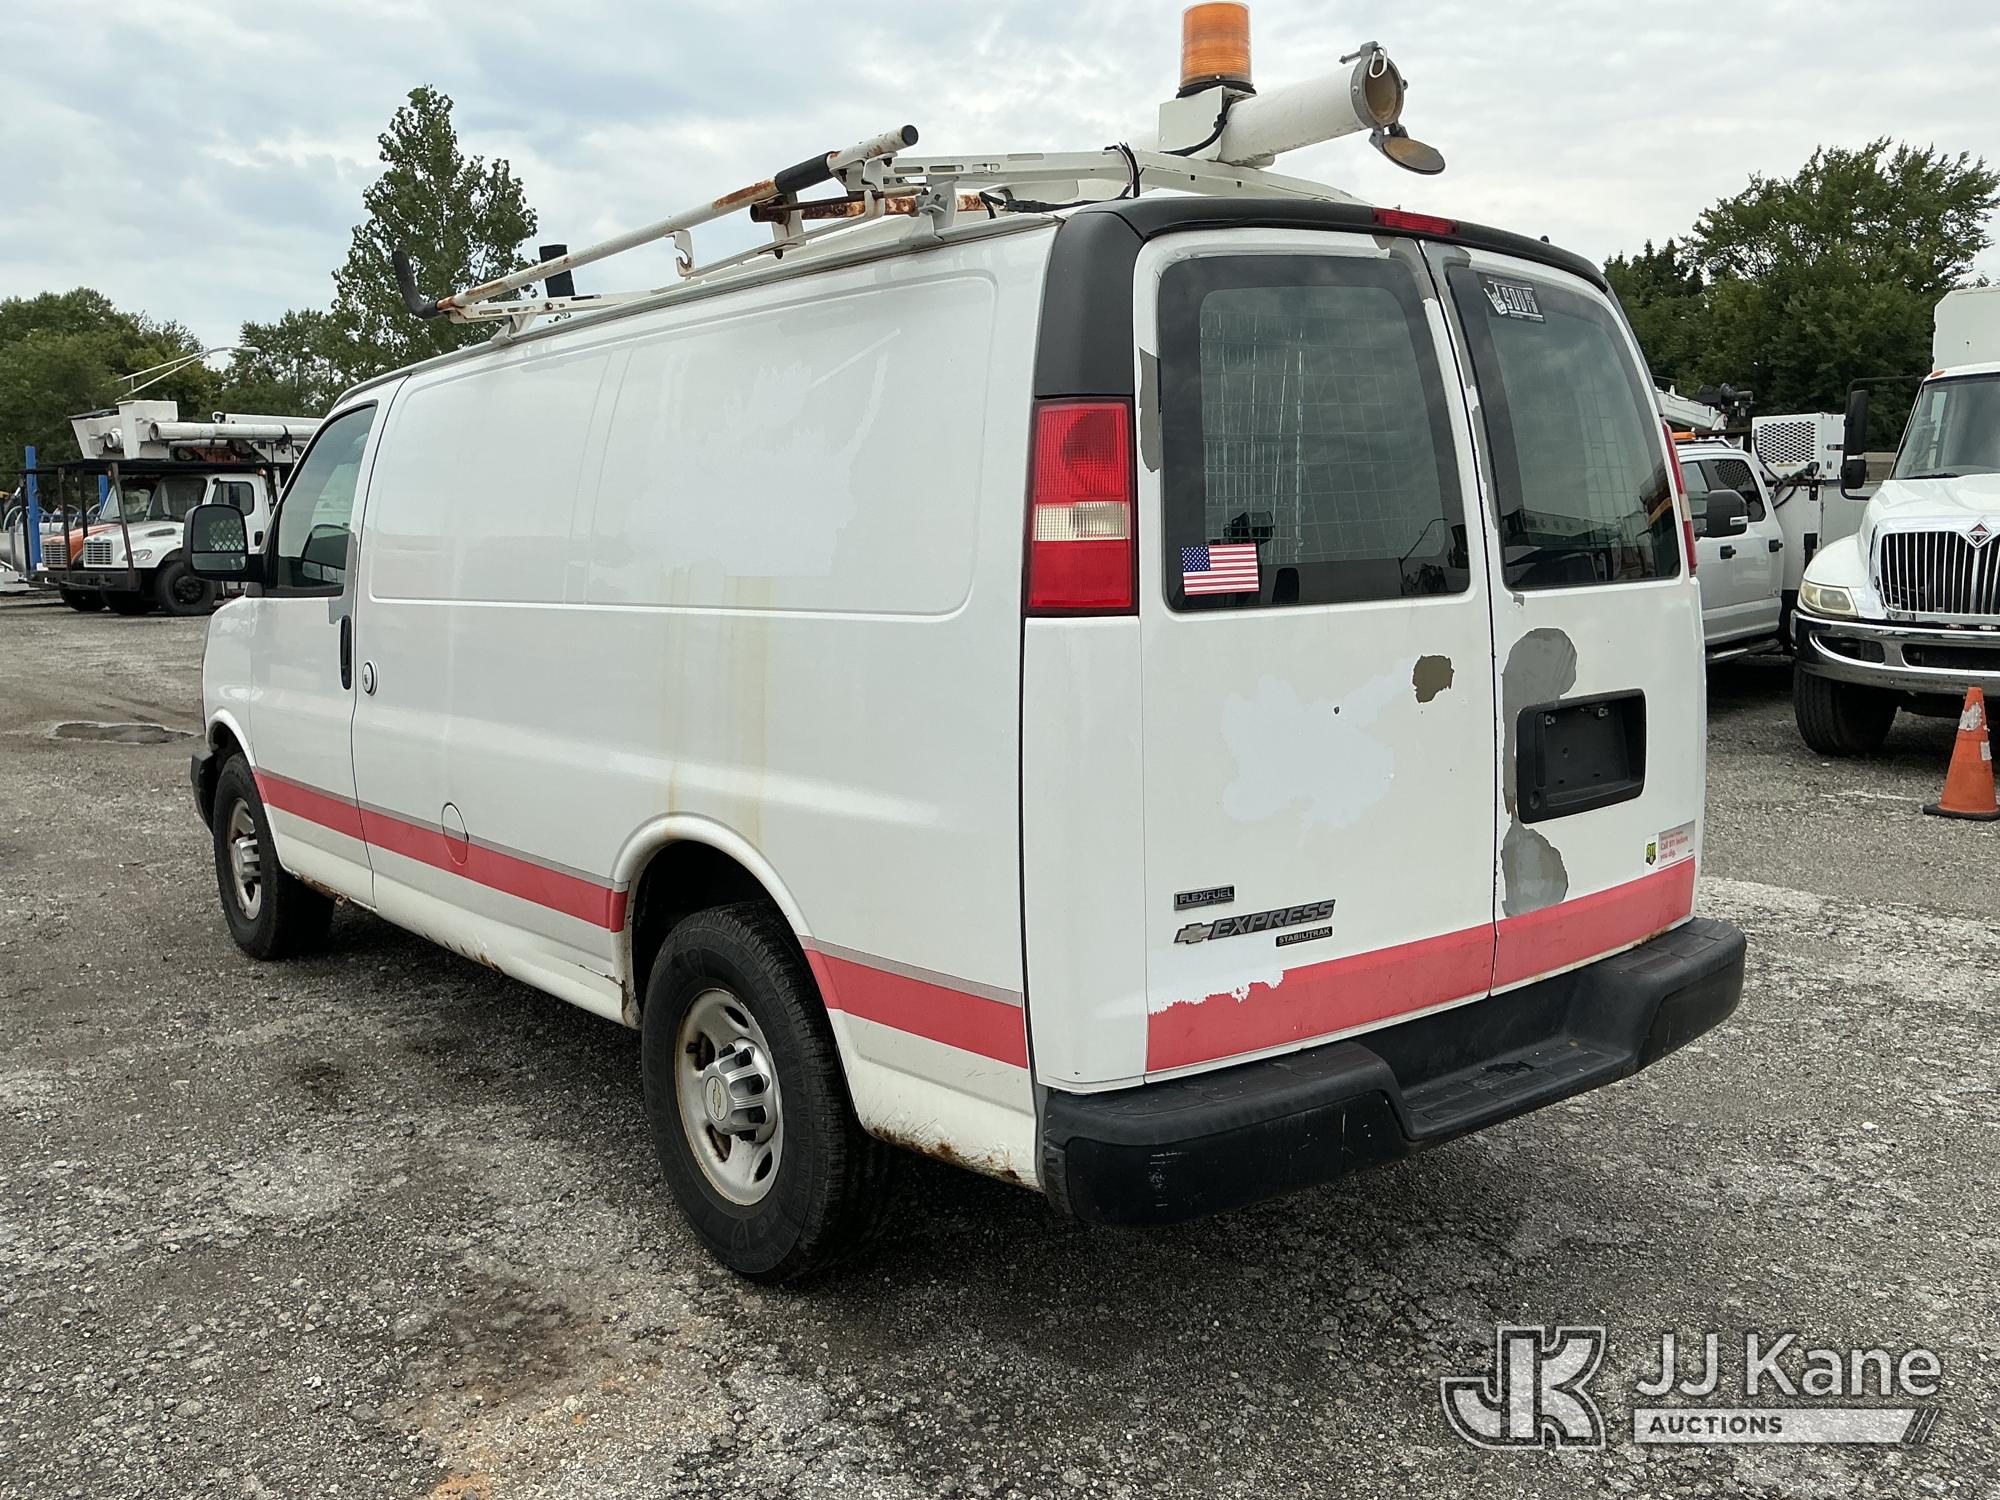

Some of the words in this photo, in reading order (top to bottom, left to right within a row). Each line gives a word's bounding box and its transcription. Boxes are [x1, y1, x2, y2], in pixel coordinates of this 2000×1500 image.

[1179, 886, 1234, 905] FLEXFUEL
[1211, 900, 1335, 938] EXPRESS
[1278, 927, 1331, 946] STABILITRAK
